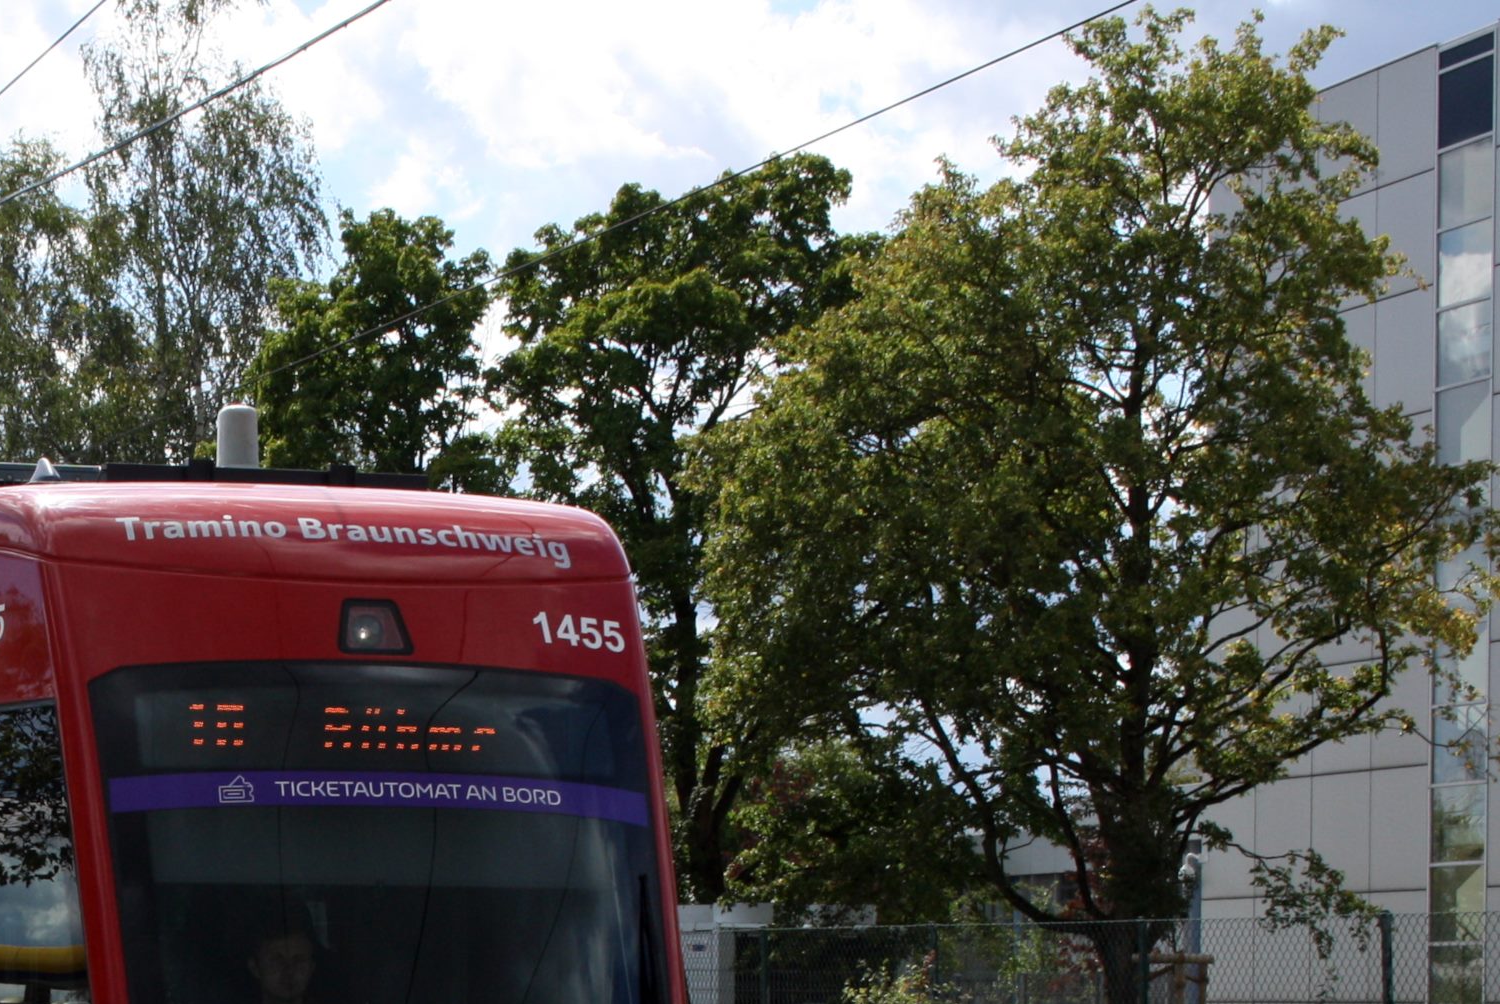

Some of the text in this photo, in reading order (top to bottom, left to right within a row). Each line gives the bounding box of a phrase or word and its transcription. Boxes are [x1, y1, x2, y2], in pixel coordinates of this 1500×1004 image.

[116, 515, 571, 568] Tramino Braunschweig
[532, 611, 626, 654] 1455
[275, 780, 562, 807] TICKETAUTOMAT AN BORD
